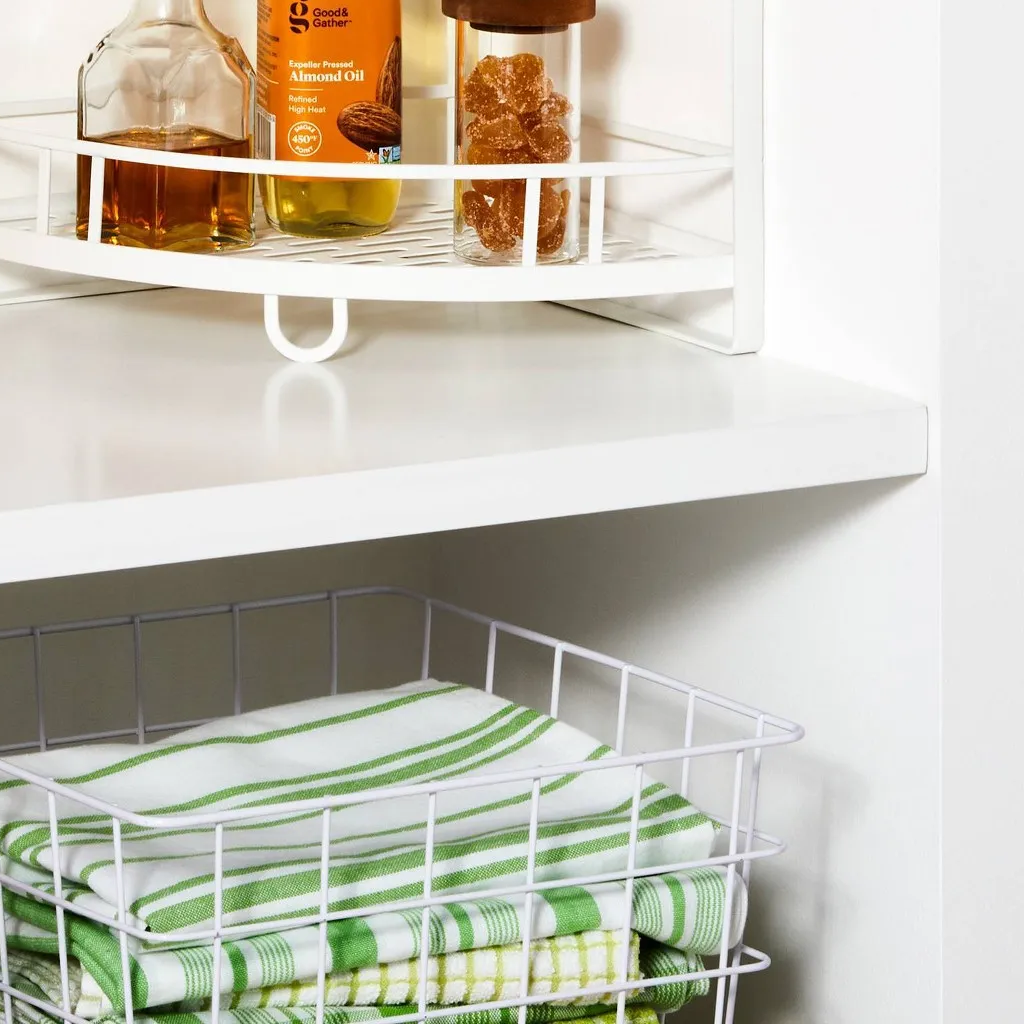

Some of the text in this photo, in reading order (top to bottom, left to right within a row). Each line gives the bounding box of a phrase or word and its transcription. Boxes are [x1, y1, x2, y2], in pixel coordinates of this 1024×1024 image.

[312, 7, 349, 17] Good&
[312, 18, 349, 28] Gather
[289, 60, 353, 69] Expeller Pressed
[289, 70, 364, 82] Almond Oil
[288, 94, 318, 103] Refined
[288, 105, 306, 114] High
[295, 145, 313, 154] POINT
